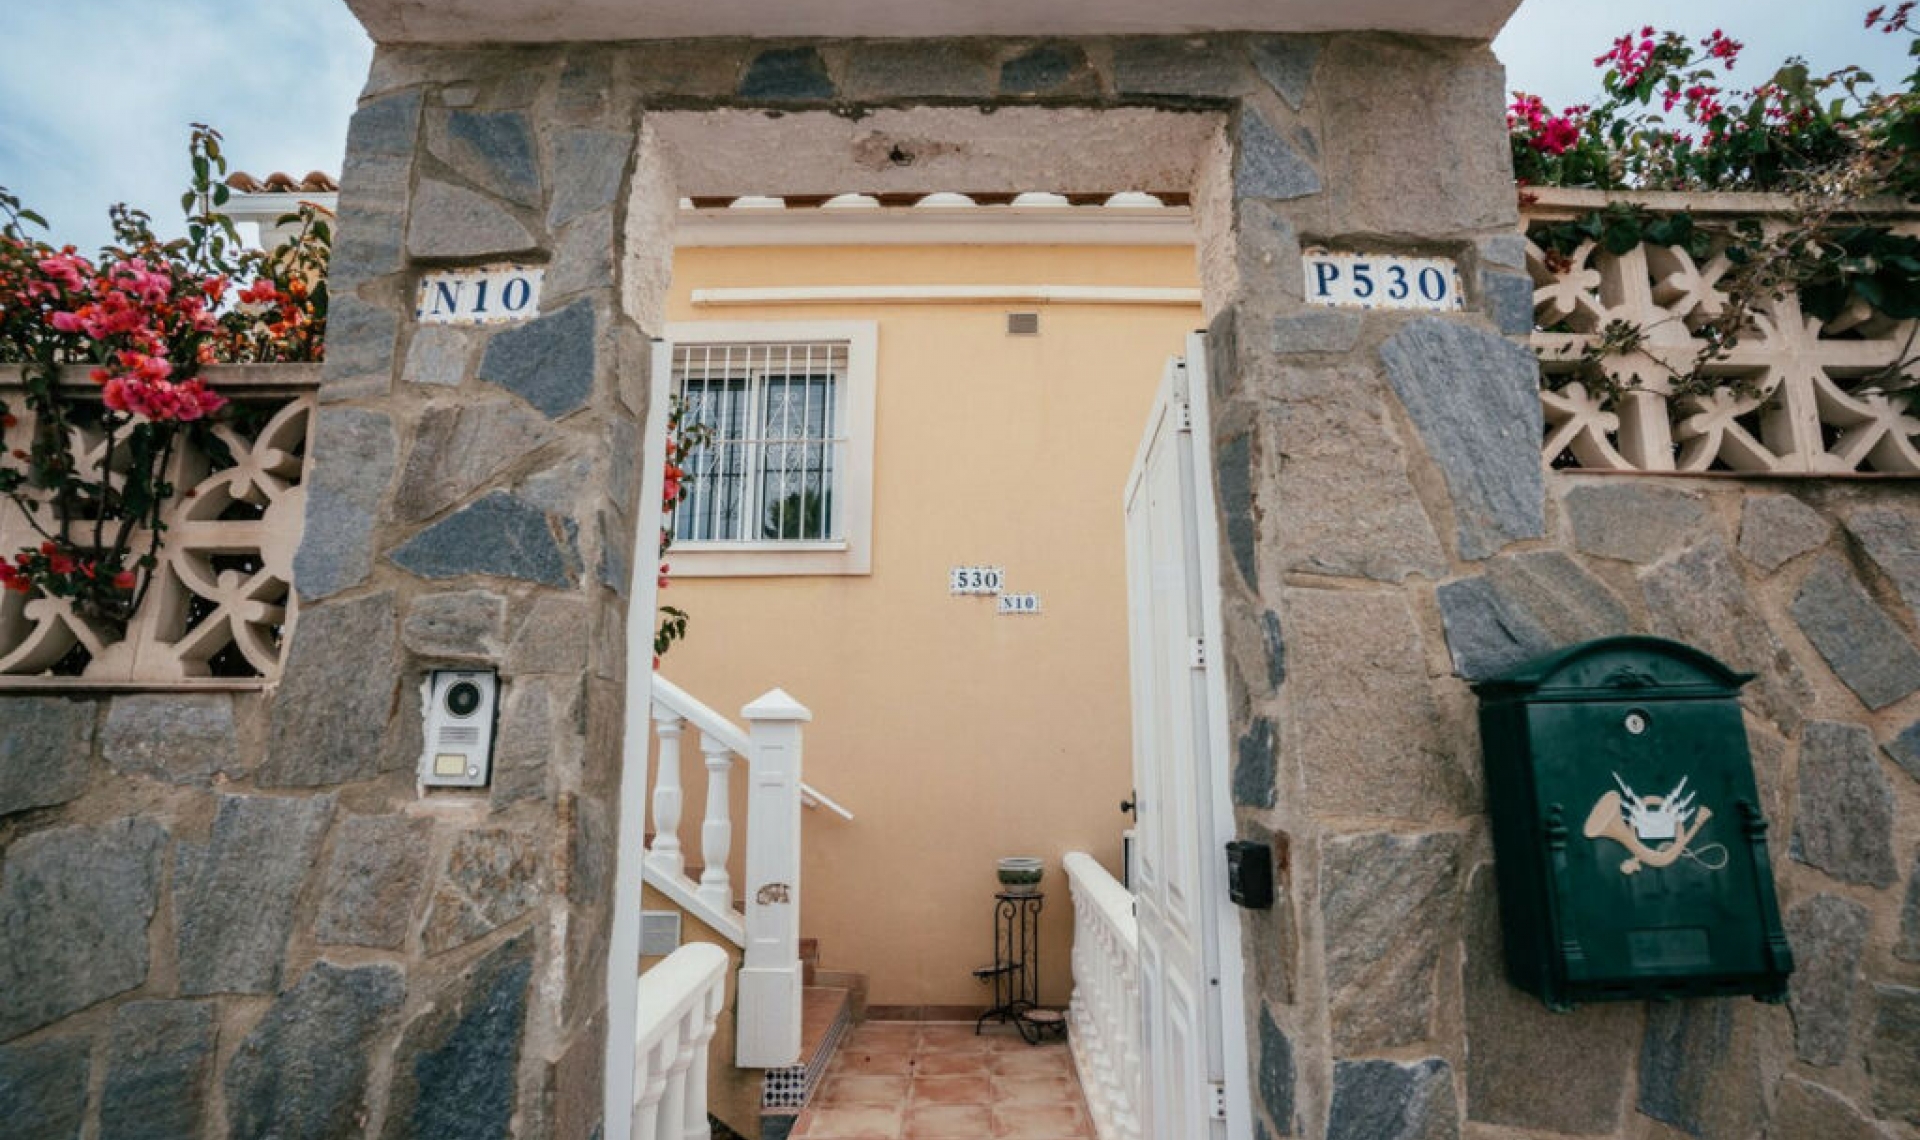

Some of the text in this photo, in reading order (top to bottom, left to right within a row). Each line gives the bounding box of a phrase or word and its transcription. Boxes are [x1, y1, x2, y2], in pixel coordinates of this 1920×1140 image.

[1312, 261, 1447, 302] P530
[430, 277, 531, 315] N10
[957, 572, 998, 589] 530
[1004, 597, 1034, 609] N10
